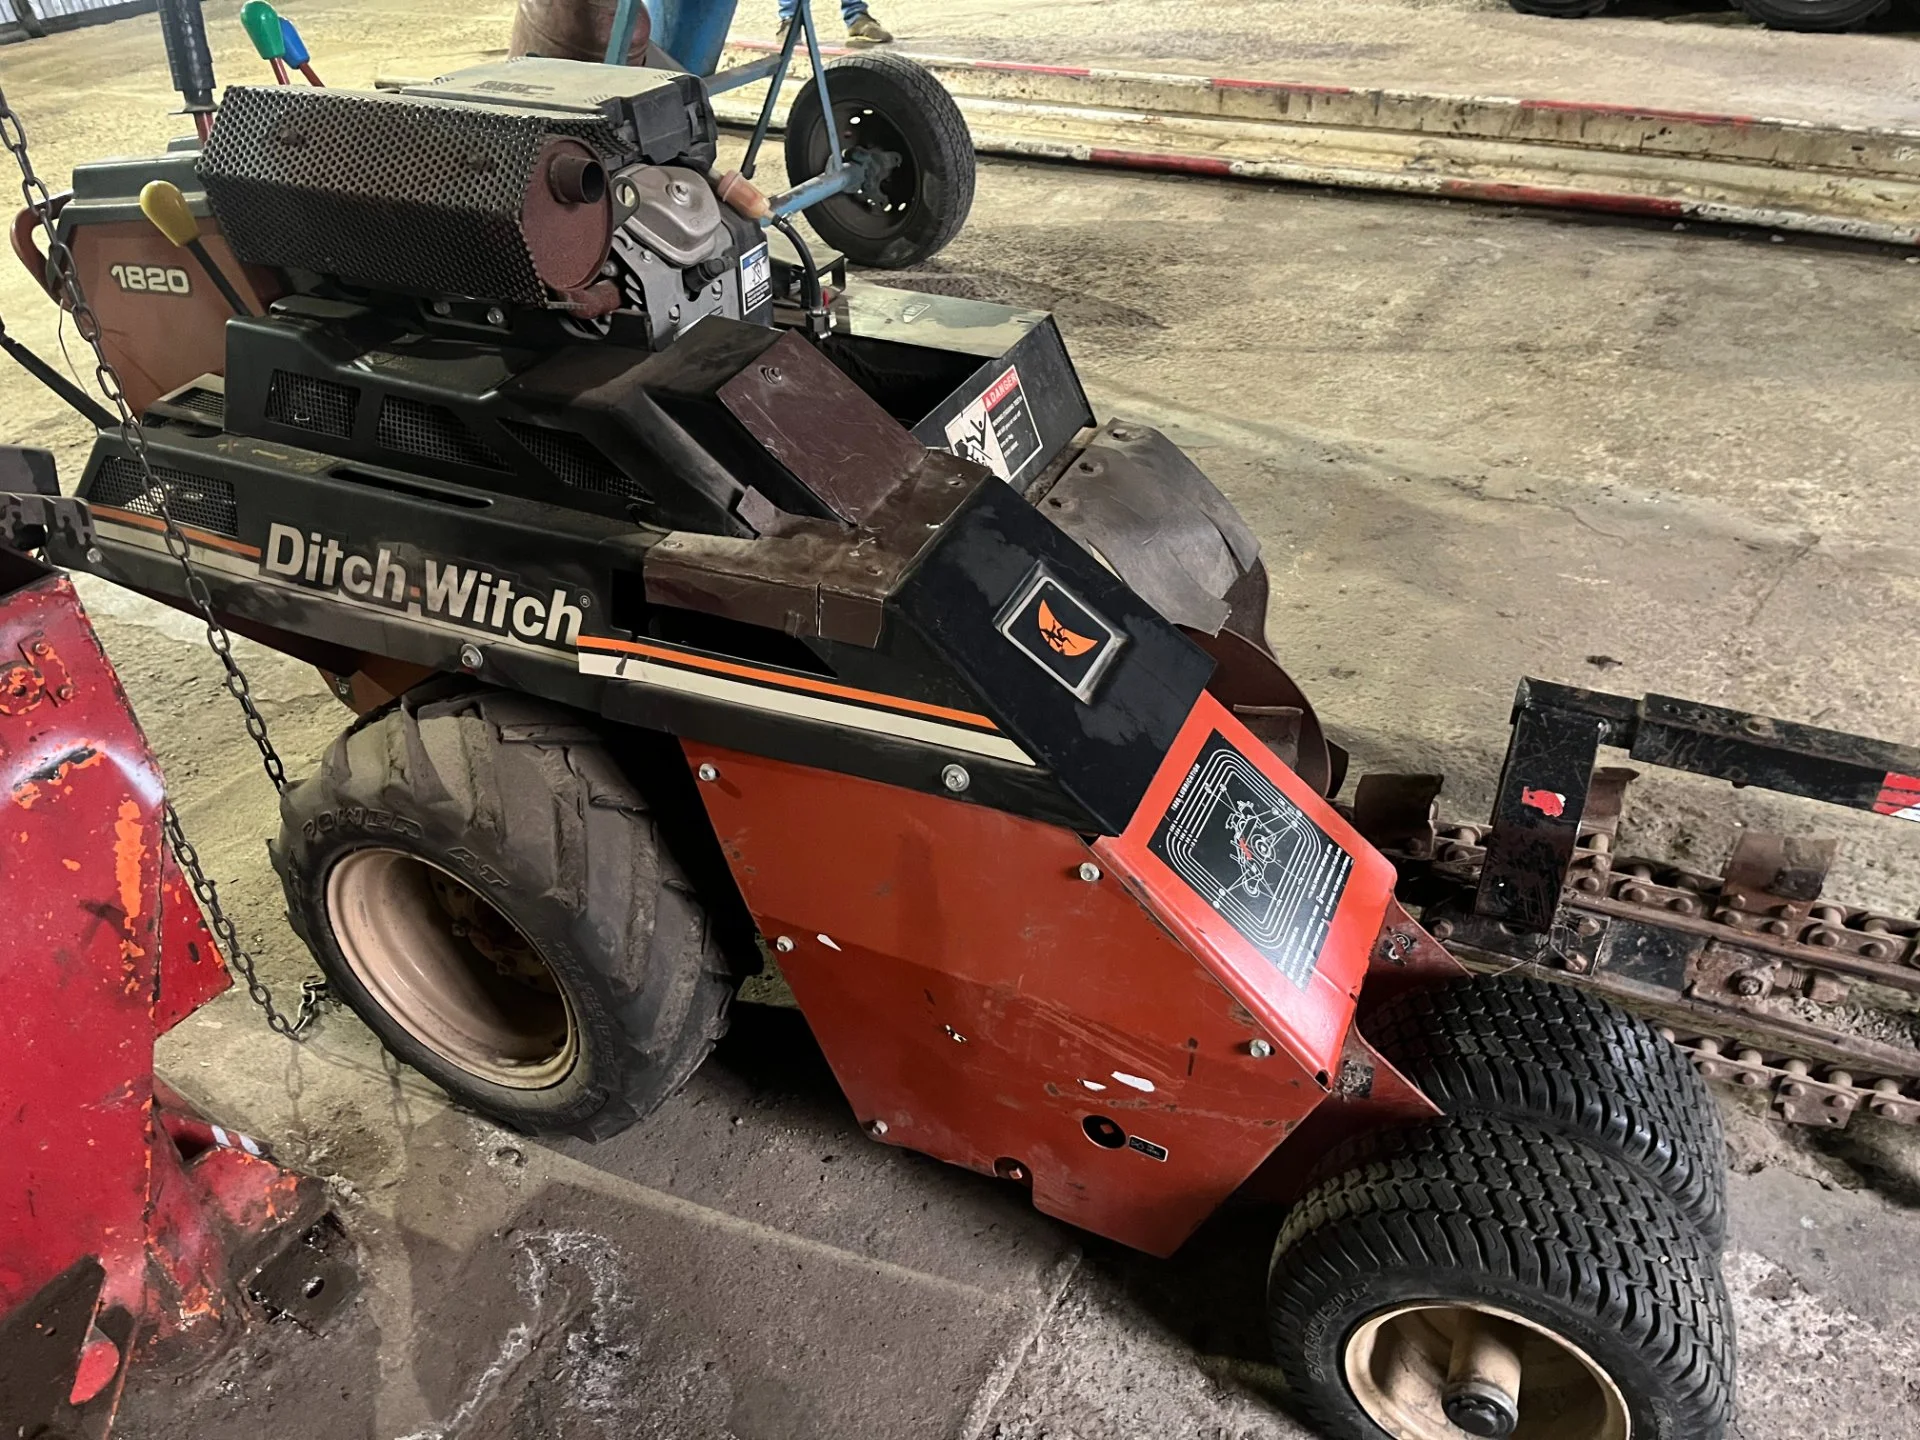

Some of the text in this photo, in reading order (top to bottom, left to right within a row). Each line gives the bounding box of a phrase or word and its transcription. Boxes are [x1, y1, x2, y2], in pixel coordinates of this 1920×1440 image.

[110, 265, 190, 293] 1820
[990, 372, 1019, 399] DANGER
[266, 522, 583, 645] Ditch Witch
[1178, 763, 1200, 799] LUBRICATION
[301, 806, 511, 887] POWER AT
